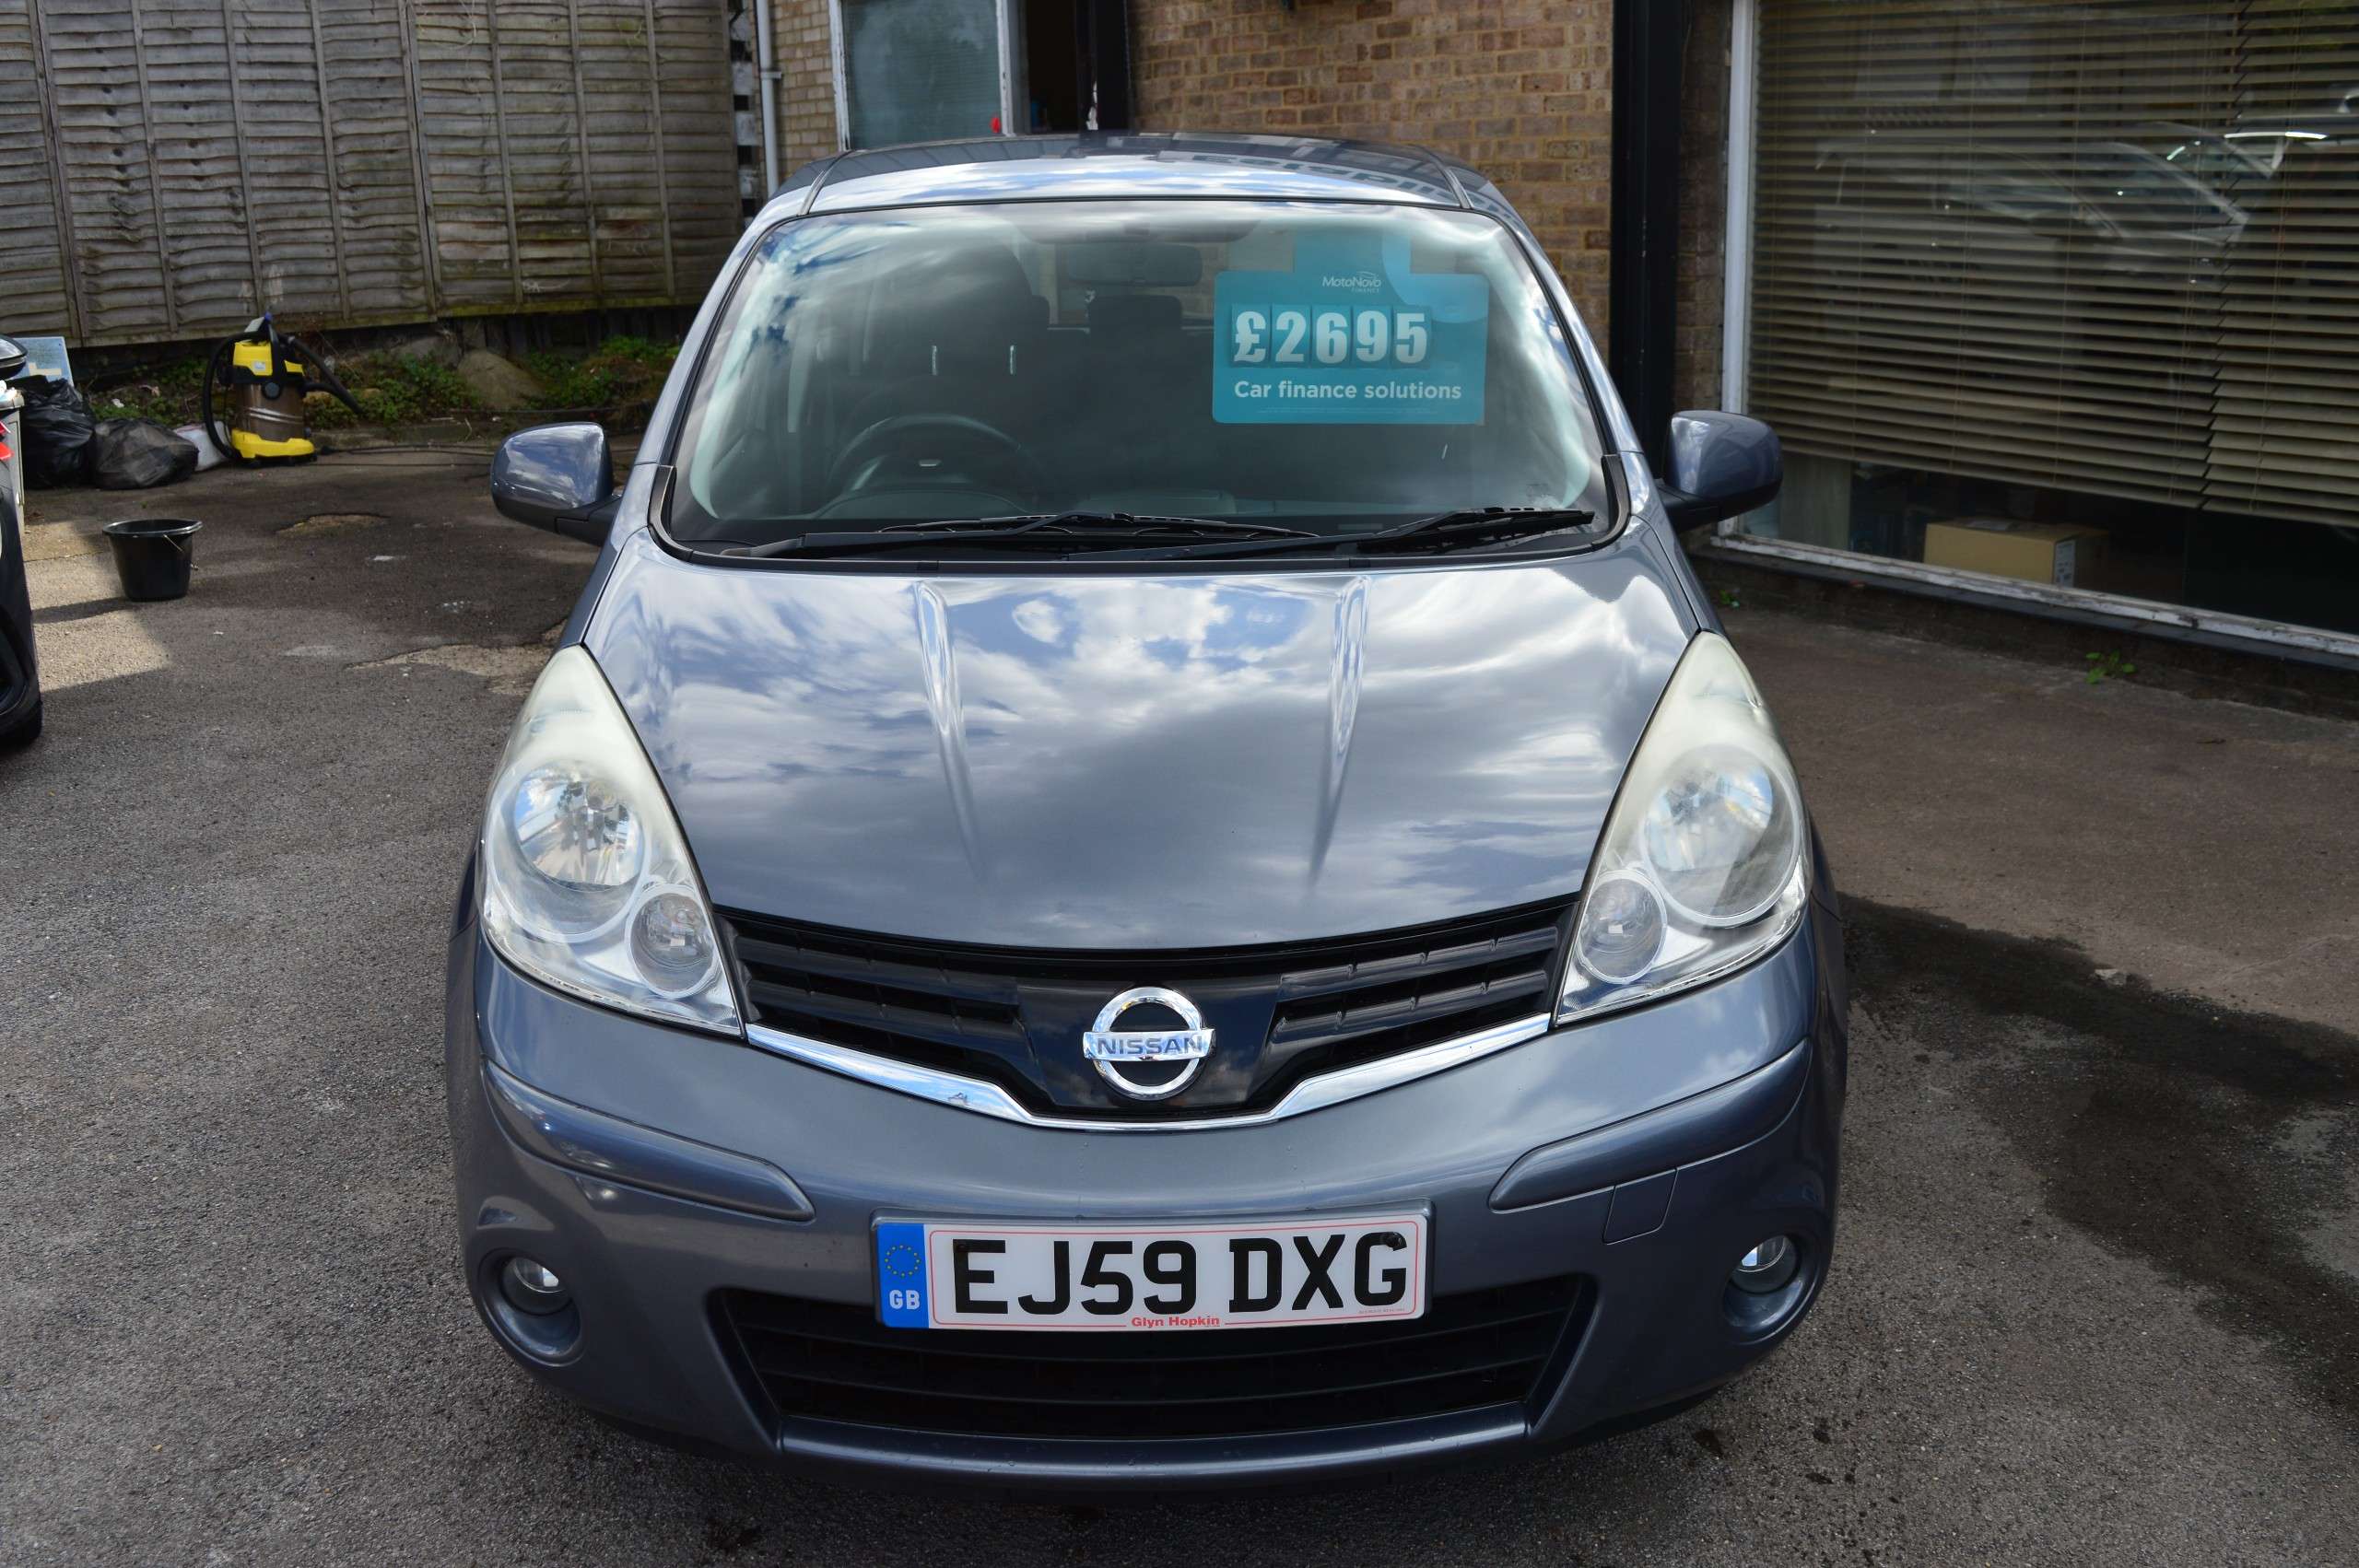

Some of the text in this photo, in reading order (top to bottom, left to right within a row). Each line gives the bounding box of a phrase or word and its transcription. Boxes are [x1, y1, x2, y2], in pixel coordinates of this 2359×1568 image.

[1321, 275, 1382, 287] MotoNovo
[1233, 310, 1427, 364] £2695
[1234, 380, 1461, 399] Car finance solutions
[1097, 1036, 1203, 1055] NISSAN
[953, 1232, 1407, 1315] EJ59 DXG
[889, 1290, 920, 1309] GB
[1132, 1316, 1220, 1328] Glyn Hopkin
